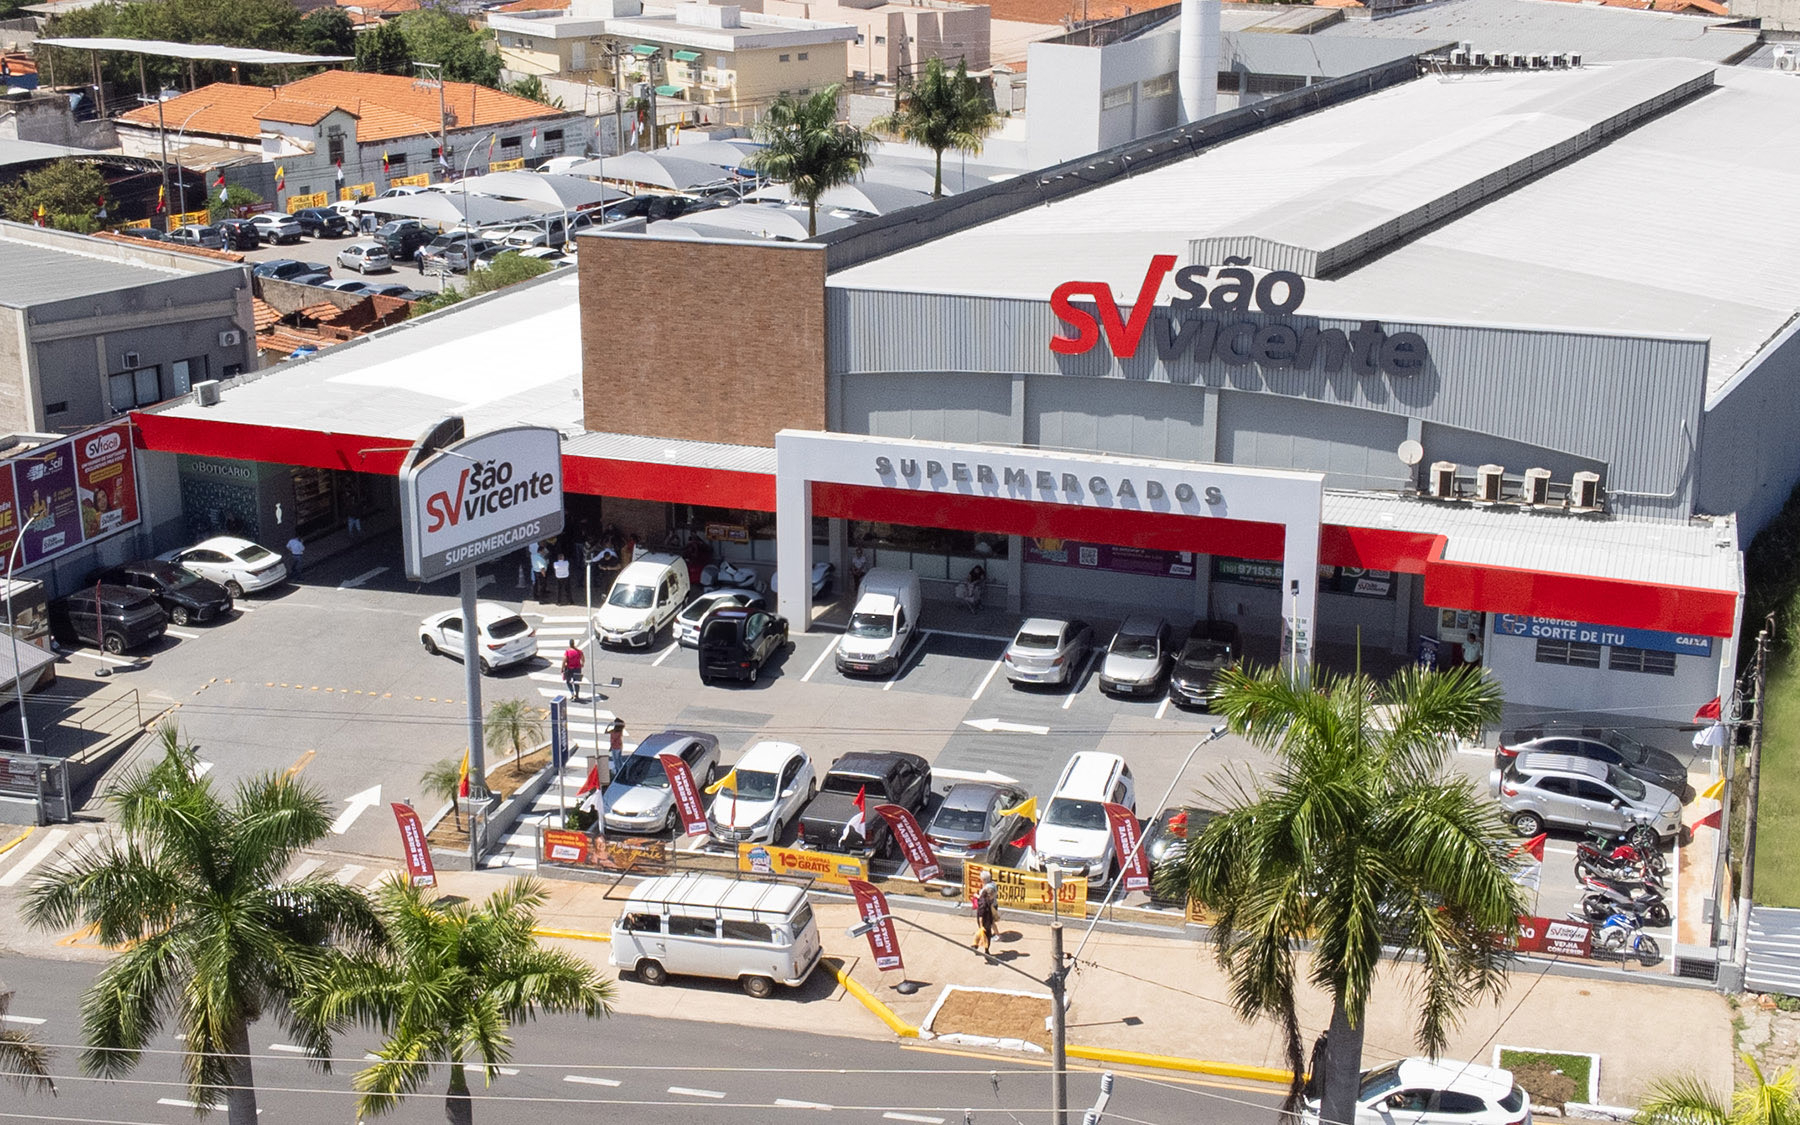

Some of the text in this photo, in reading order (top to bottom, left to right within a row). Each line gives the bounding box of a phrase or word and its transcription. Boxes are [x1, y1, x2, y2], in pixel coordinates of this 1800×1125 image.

[1170, 255, 1305, 315] são
[1049, 254, 1178, 359] SV
[1154, 319, 1428, 377] vicente
[469, 459, 513, 495] são
[875, 456, 1222, 505] SUPERMERCADOS
[426, 468, 470, 533] SV
[464, 471, 553, 521] vicente
[445, 521, 541, 566] SUPERMERCADOS
[1531, 625, 1625, 646] SORTE DE ITU
[1675, 636, 1708, 647] CAIXA
[674, 774, 688, 802] BREVE
[404, 825, 416, 853] BREVE
[896, 822, 915, 848] BREVE
[990, 869, 1026, 886] LEITE
[873, 933, 884, 948] EM
[881, 927, 893, 953] MUITAS
